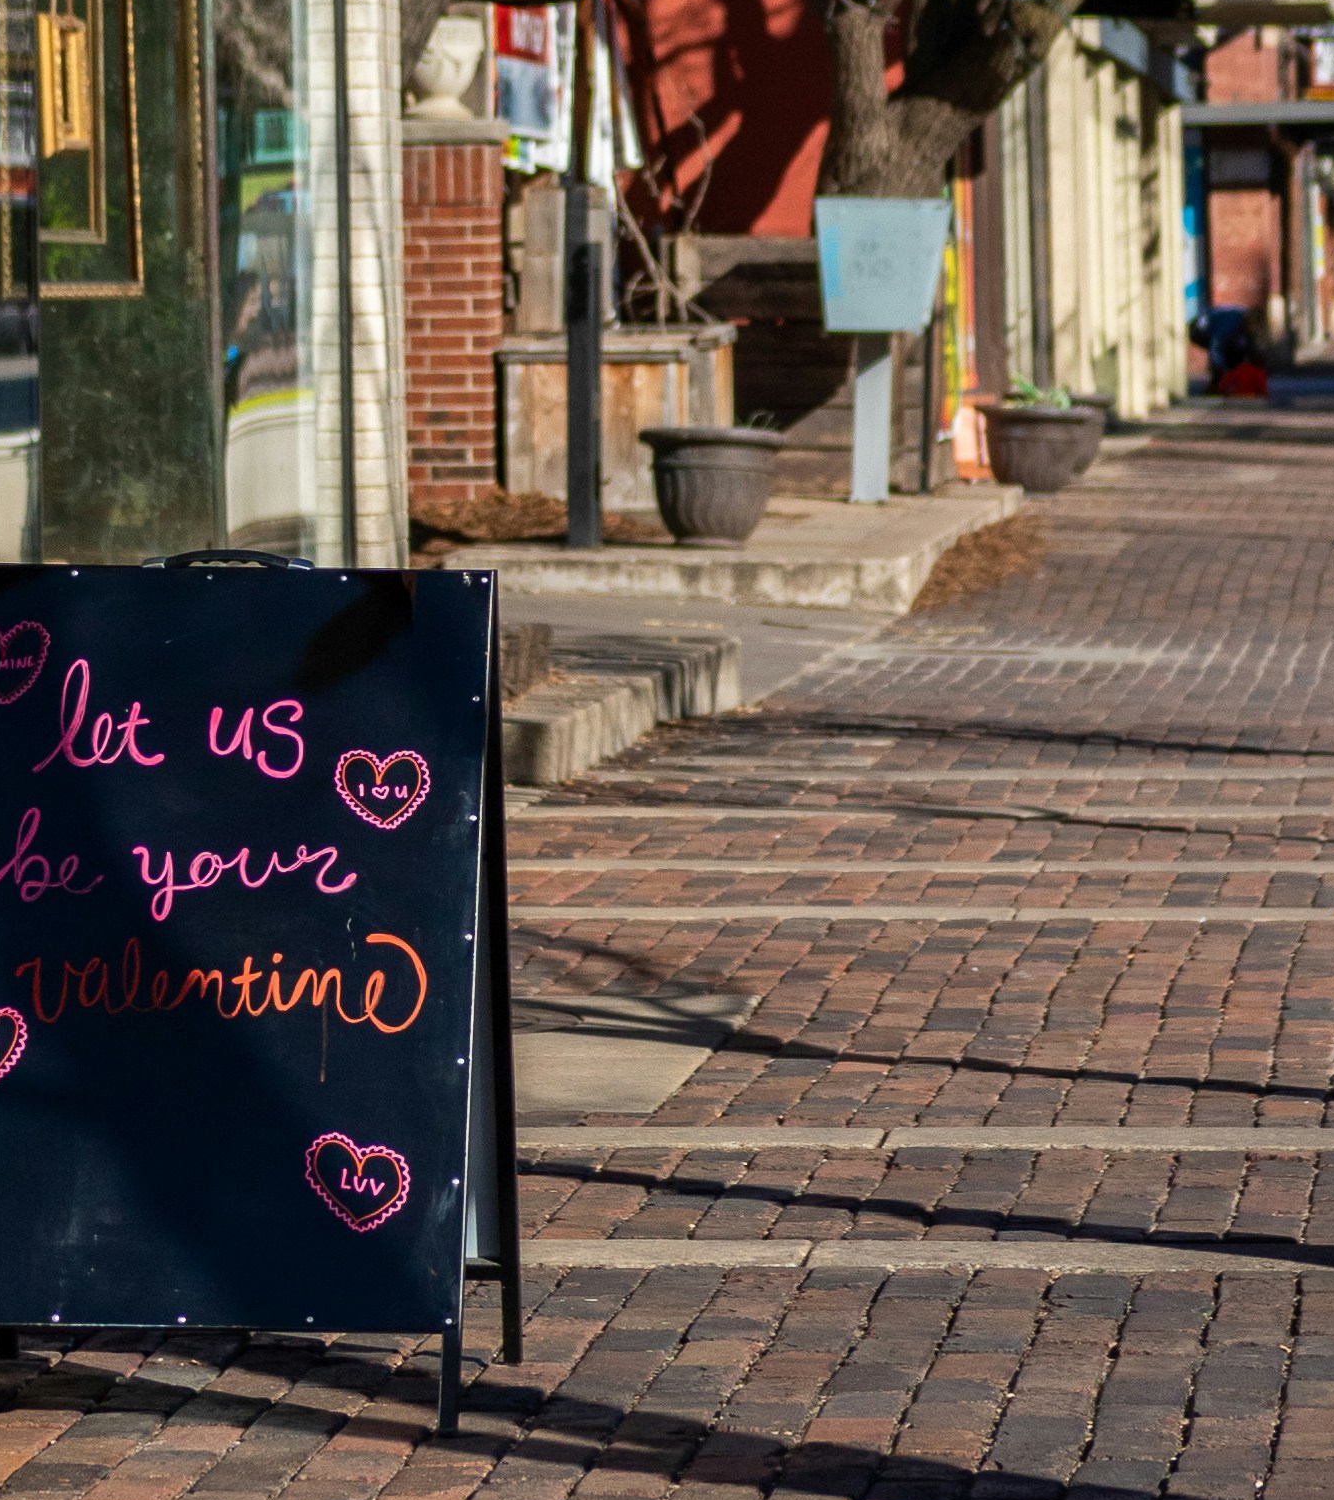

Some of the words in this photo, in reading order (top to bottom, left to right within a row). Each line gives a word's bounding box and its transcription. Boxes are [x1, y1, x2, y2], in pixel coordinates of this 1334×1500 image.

[31, 658, 165, 773] let
[132, 845, 358, 922] your
[340, 1167, 386, 1197] LUV
